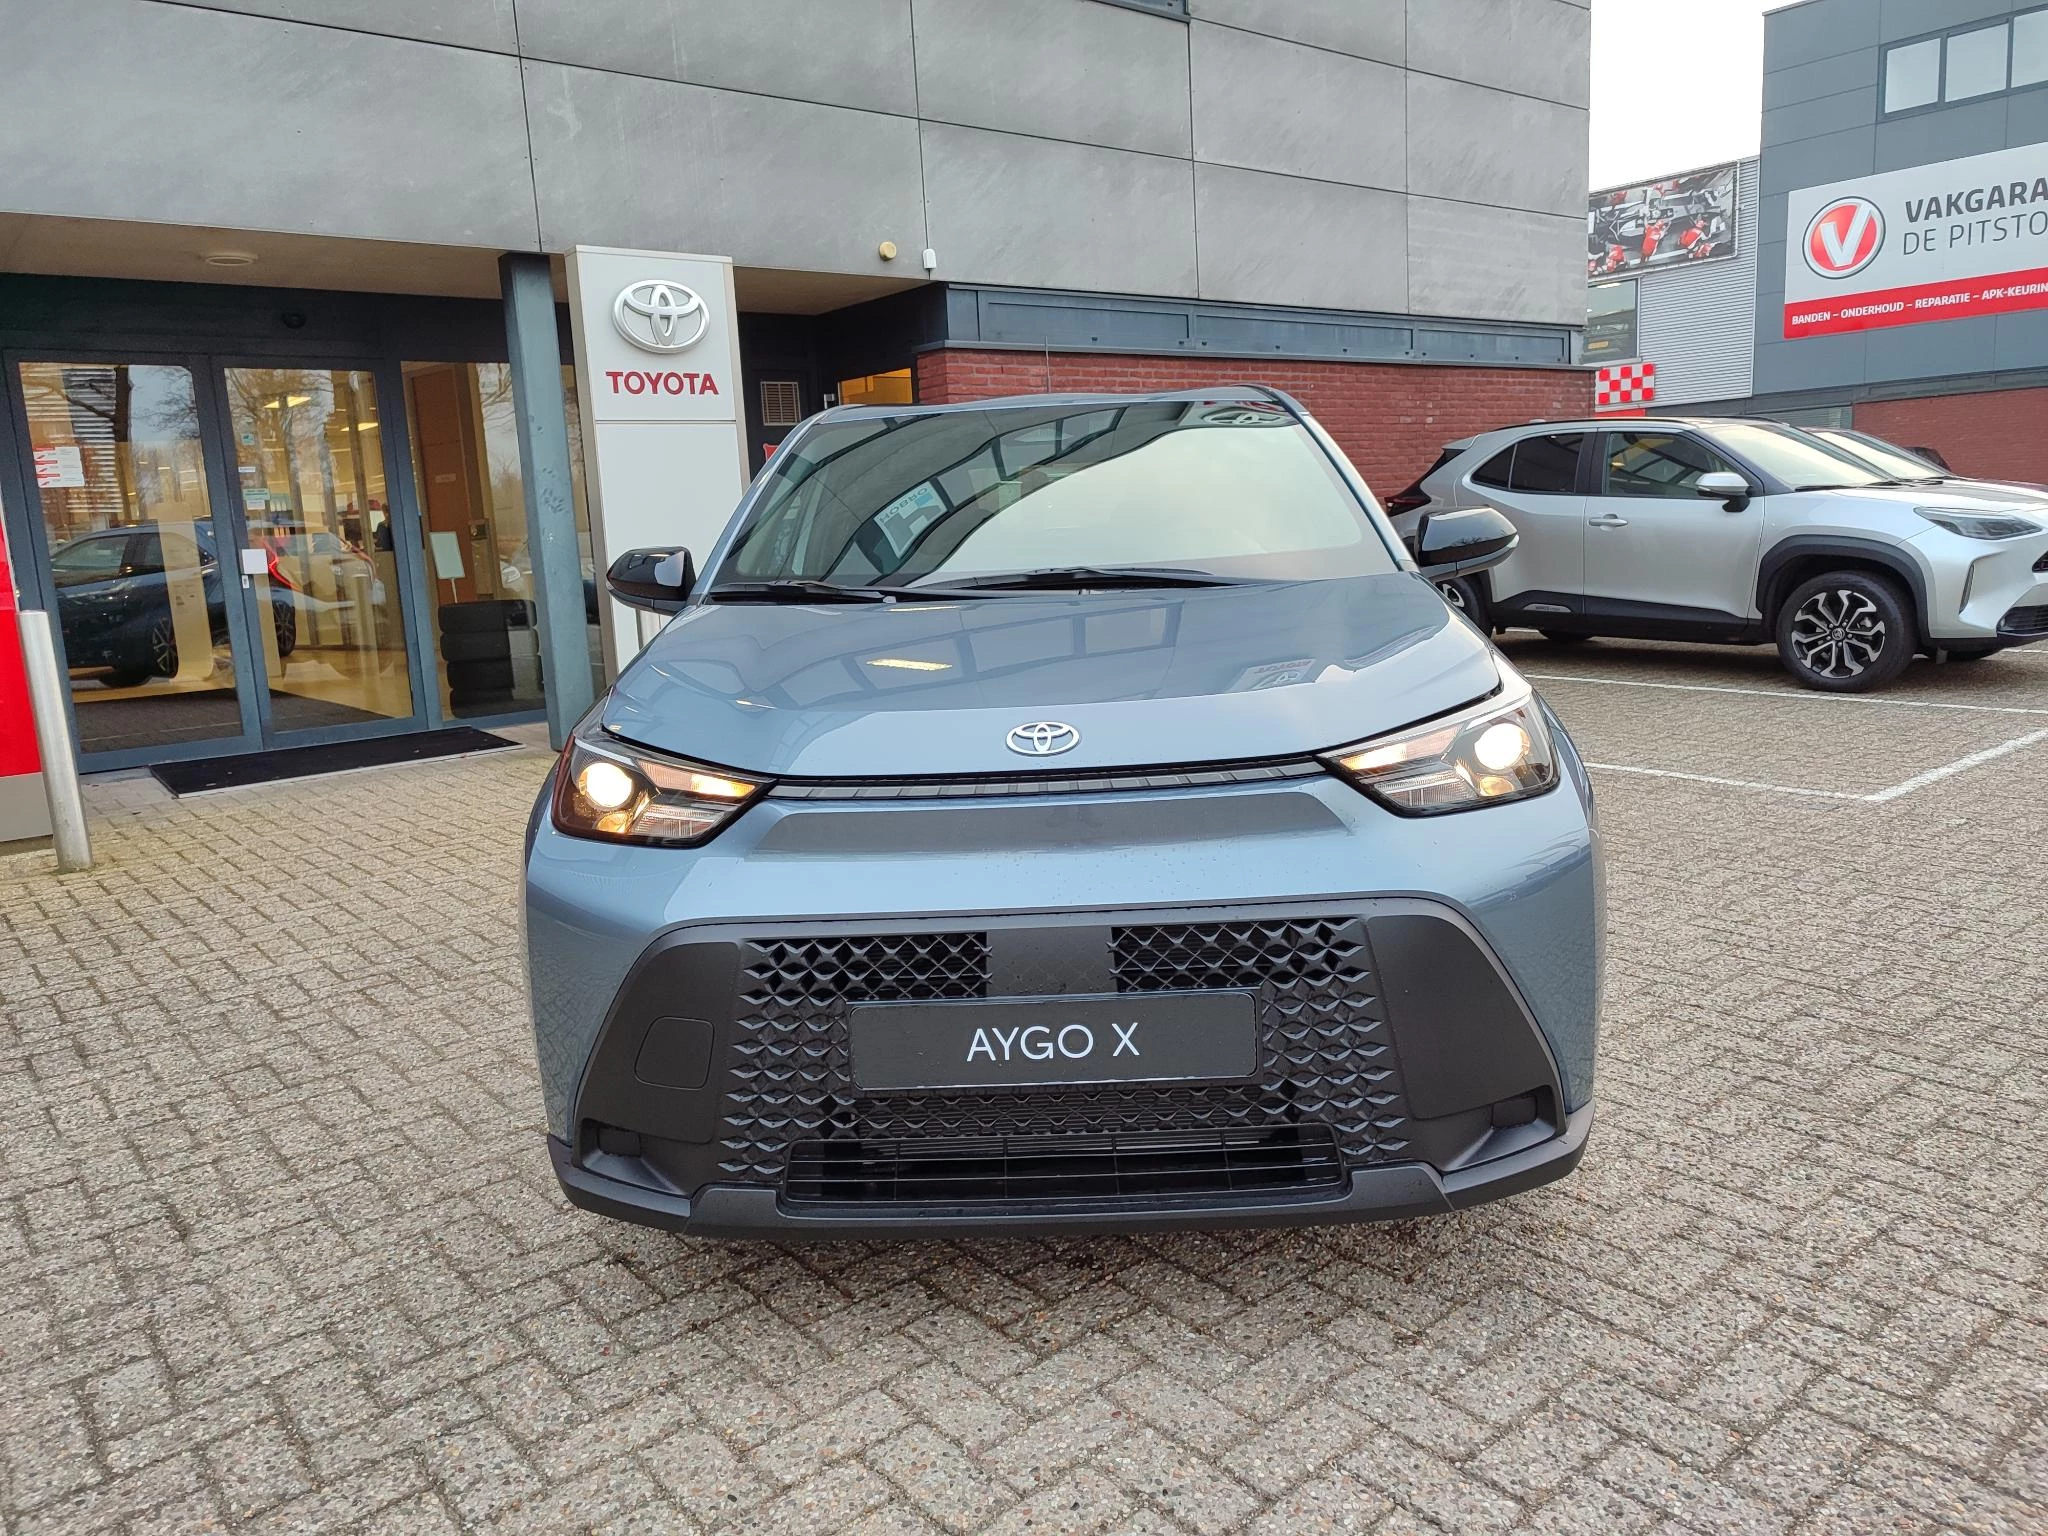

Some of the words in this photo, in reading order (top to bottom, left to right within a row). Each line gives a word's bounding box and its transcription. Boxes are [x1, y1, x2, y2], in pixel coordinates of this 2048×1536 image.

[1905, 177, 2048, 223] VAKGARA
[1903, 228, 1937, 256] DE
[1949, 211, 2048, 249] PITSTO
[1791, 311, 1831, 326] BANDEN
[1840, 301, 1904, 319] ONDERHOUD
[1914, 293, 1971, 309] REPARATIE
[605, 371, 720, 396] TOYOTA
[966, 1024, 1094, 1062] AYGO
[1111, 1022, 1140, 1057] X
